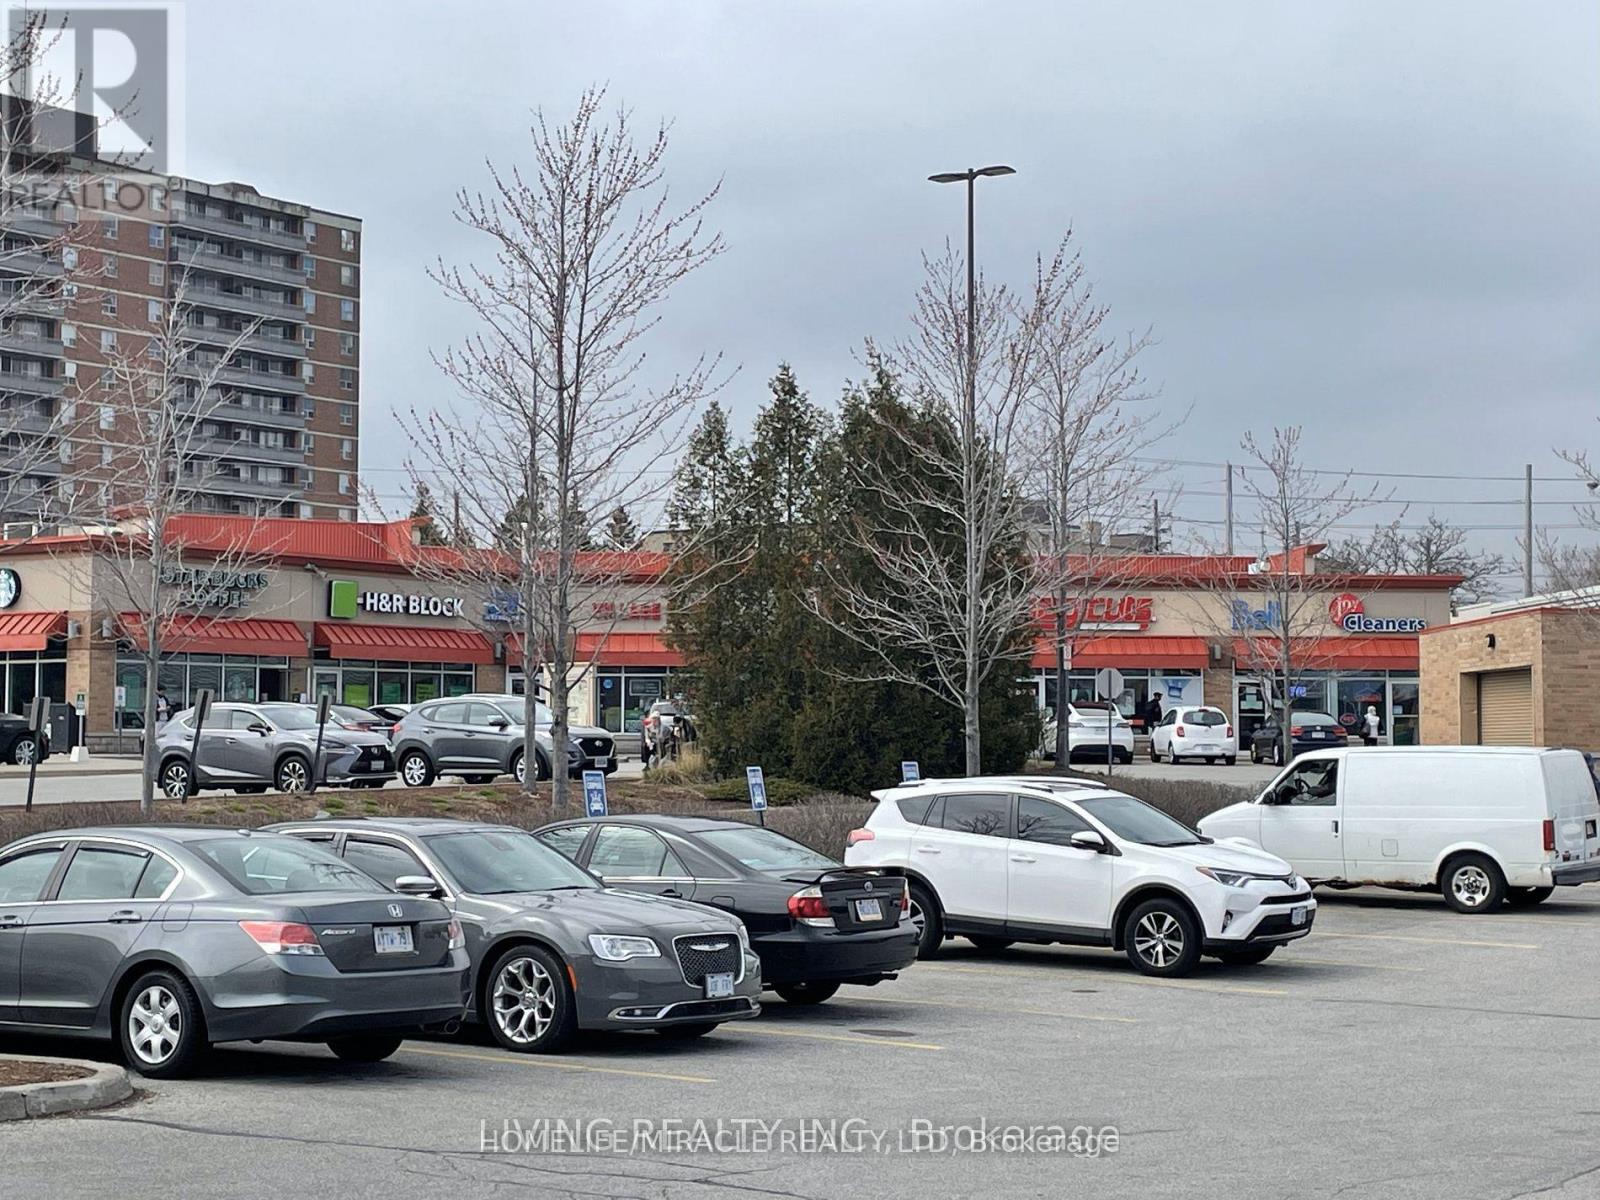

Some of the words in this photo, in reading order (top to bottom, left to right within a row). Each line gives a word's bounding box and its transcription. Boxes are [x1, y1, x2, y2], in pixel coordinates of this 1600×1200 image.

[366, 592, 406, 613] H&R
[409, 595, 465, 617] BLOCK
[1344, 613, 1426, 632] Cleaners
[321, 927, 356, 937] Accord
